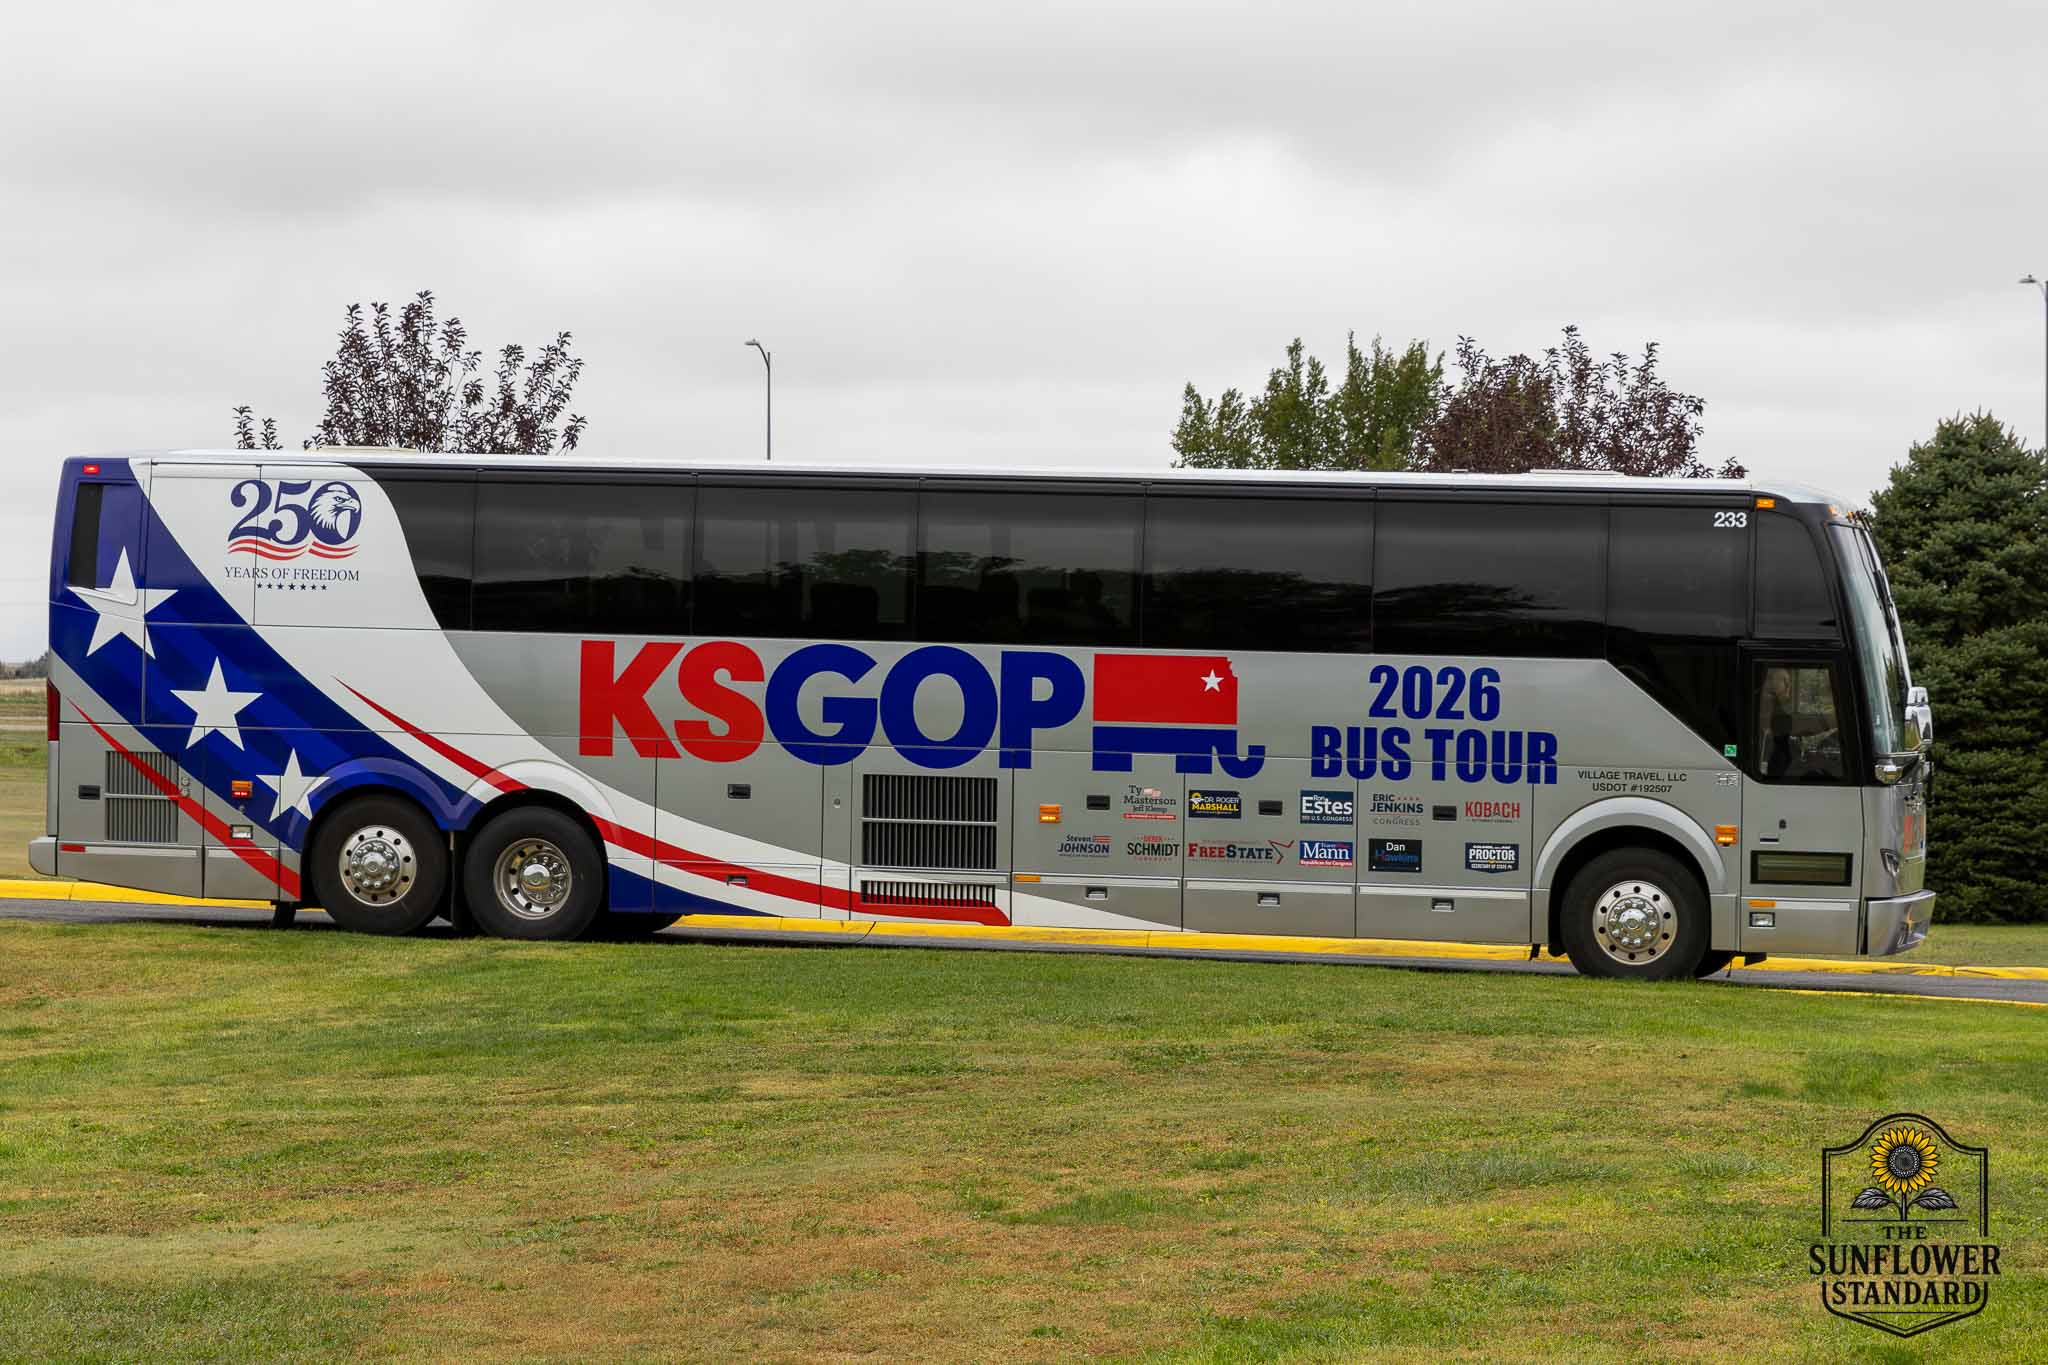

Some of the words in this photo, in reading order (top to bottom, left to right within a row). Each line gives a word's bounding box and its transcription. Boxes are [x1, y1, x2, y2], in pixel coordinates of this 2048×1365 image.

[227, 480, 362, 545] 250
[1713, 511, 1747, 527] 233
[225, 566, 269, 579] YEARS
[271, 568, 290, 580] OF
[293, 569, 360, 581] FREEDOM
[1368, 665, 1501, 722] 2026
[1311, 726, 1412, 781] BUS
[1424, 728, 1558, 785] TOUR
[1577, 770, 1621, 781] VILLAGE
[1623, 771, 1665, 782] TRAVEL,
[1667, 773, 1688, 782] LLC
[1128, 785, 1142, 797] Ty
[1592, 783, 1628, 792] USDOT
[1630, 784, 1673, 793] #192507
[1122, 795, 1177, 806] Masterson
[1203, 796, 1215, 804] DR
[1372, 793, 1396, 803] ERIC
[1191, 803, 1240, 812] MARSHALL
[1301, 796, 1353, 815] Estes
[1369, 802, 1424, 814] JENKINS
[1465, 801, 1520, 819] KOBACH
[1372, 817, 1421, 826] CONGRESS
[1066, 834, 1092, 842] Steven
[1057, 842, 1110, 854] JOHNSON
[1127, 842, 1181, 857] SCHMIDT
[1303, 842, 1350, 860] Mann
[1386, 842, 1406, 852] Dan
[1469, 848, 1516, 861] PROCTOR
